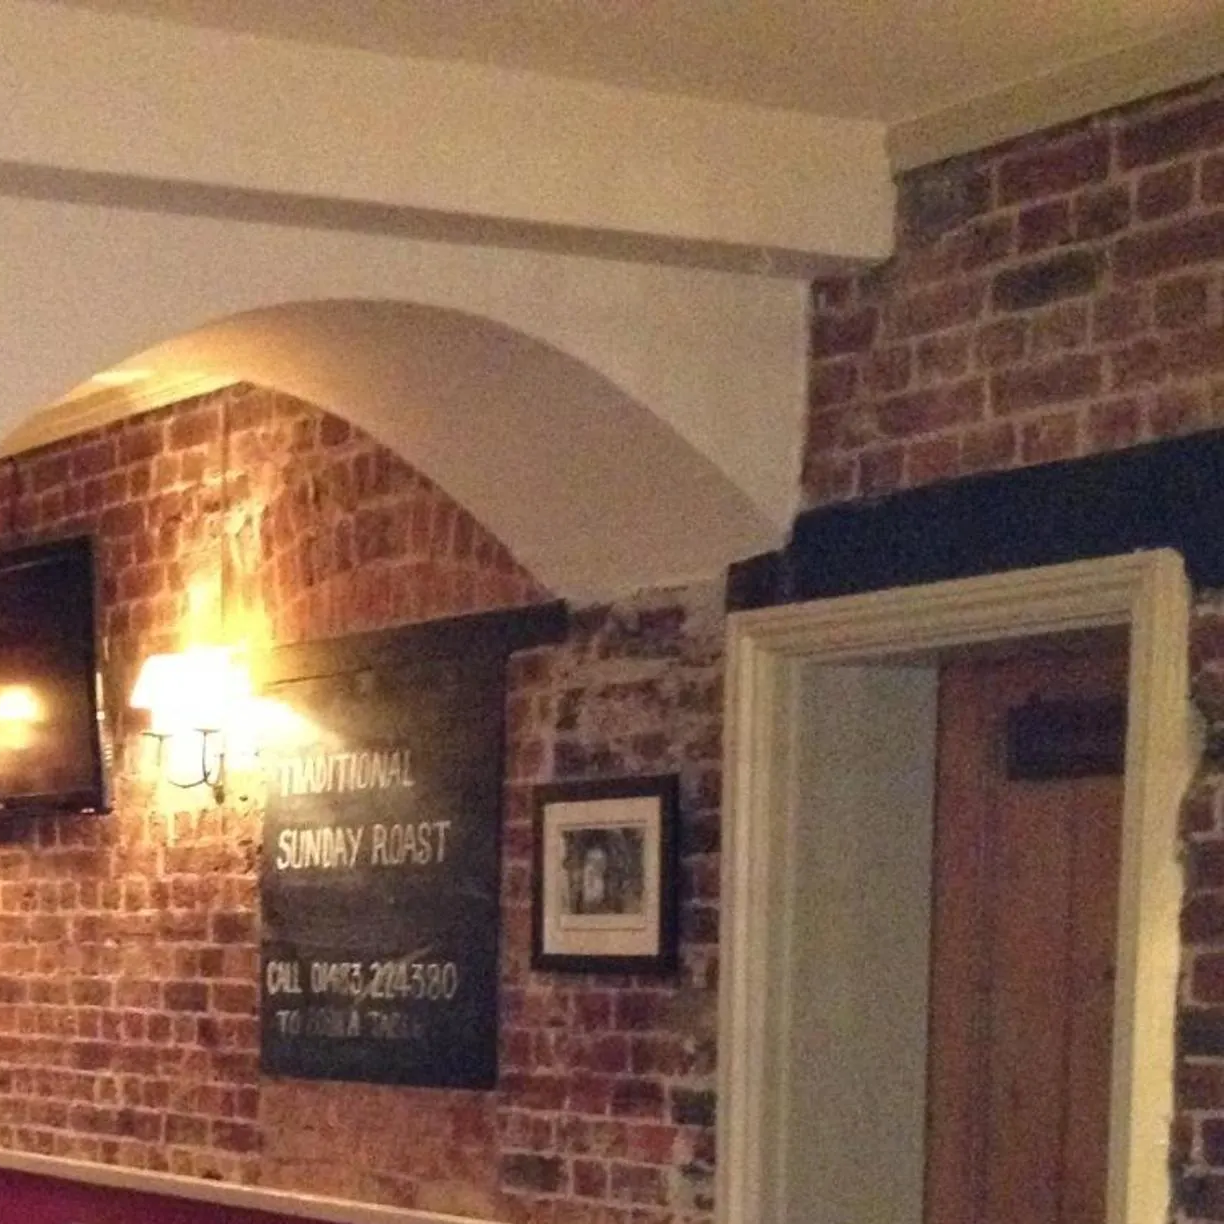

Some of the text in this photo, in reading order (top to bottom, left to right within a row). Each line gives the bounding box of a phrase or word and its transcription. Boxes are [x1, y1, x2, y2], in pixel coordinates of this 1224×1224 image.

[276, 820, 452, 871] SUNDAY ROAST
[266, 961, 303, 996] CALL
[276, 1009, 301, 1036] TO
